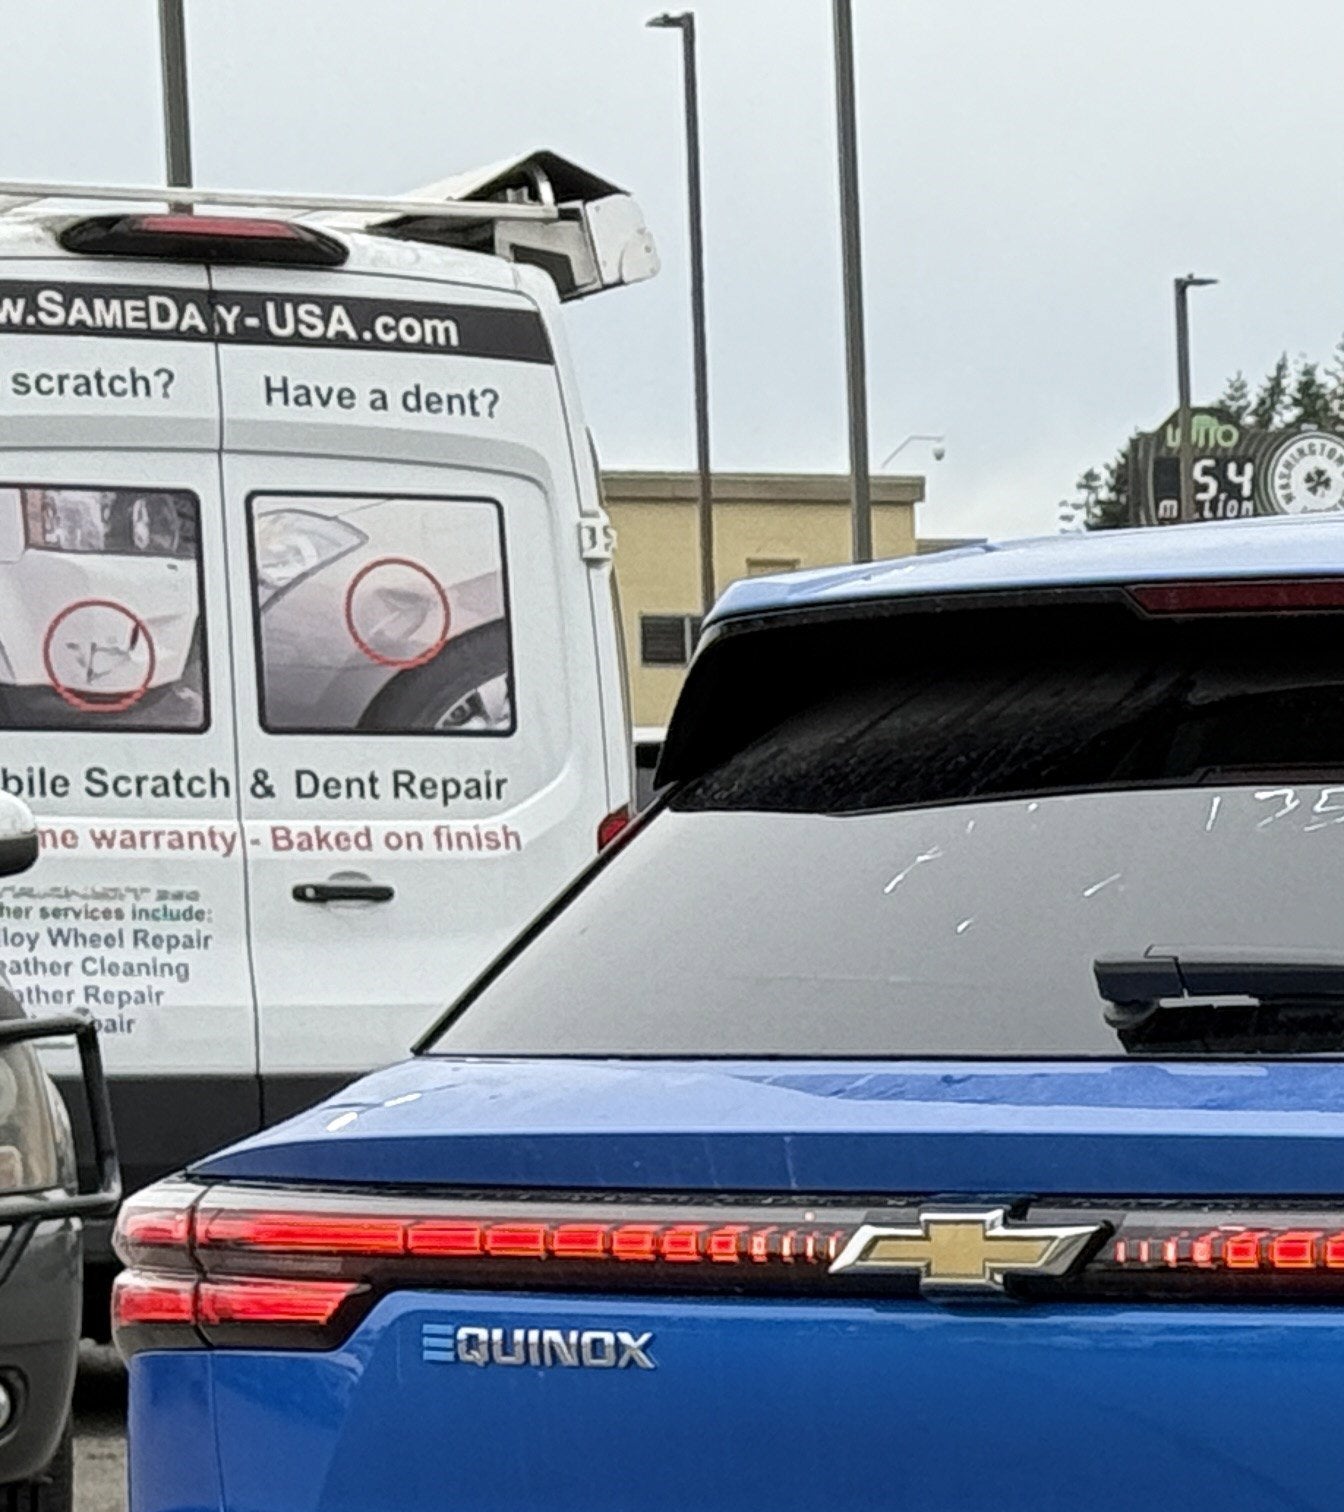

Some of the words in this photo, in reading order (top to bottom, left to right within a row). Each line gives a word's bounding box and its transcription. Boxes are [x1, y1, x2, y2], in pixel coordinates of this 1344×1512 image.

[11, 366, 175, 399] scratch?
[264, 375, 357, 410] Have
[369, 388, 389, 412] a
[401, 383, 500, 419] dent?
[84, 766, 231, 800] Scratch
[250, 768, 276, 800] &
[295, 769, 381, 800] Dent
[392, 769, 508, 807] Repair
[89, 826, 238, 858] warranty
[270, 826, 373, 852] Baked
[384, 830, 424, 852] on
[433, 825, 522, 853] finish
[39, 903, 125, 921] services
[131, 903, 214, 923] include:
[47, 928, 125, 949] Wheel
[133, 929, 214, 954] Repair
[81, 956, 190, 983] Cleaning
[84, 984, 166, 1009] Repair
[422, 1323, 656, 1369] EQUINOX
